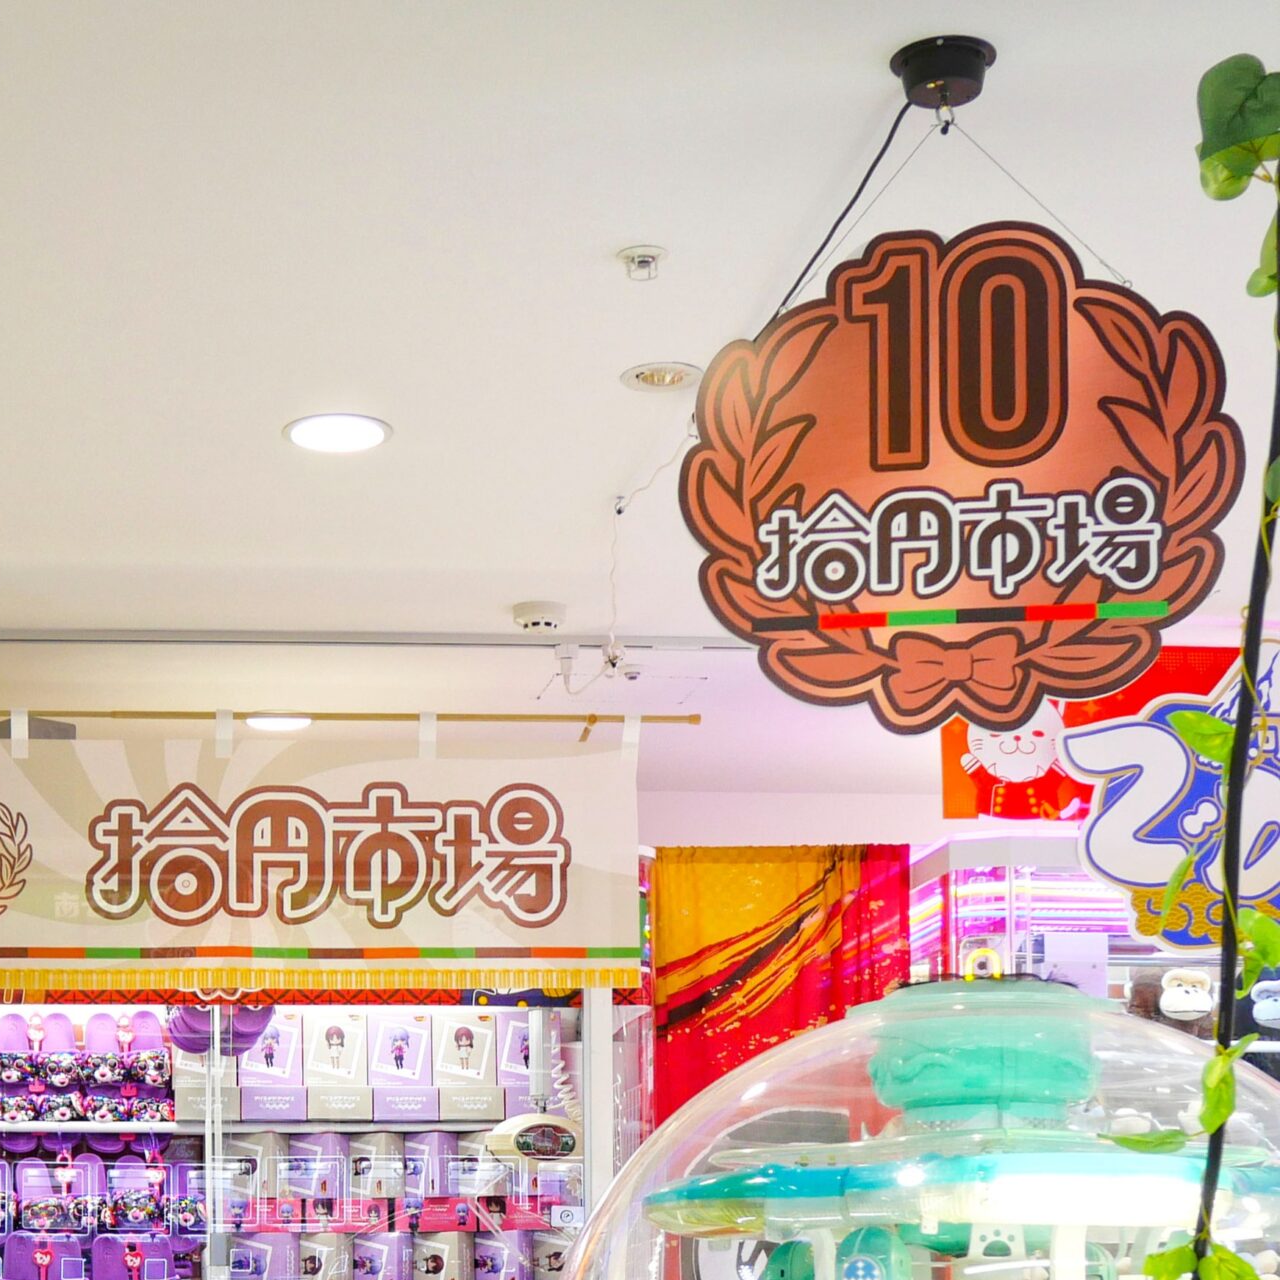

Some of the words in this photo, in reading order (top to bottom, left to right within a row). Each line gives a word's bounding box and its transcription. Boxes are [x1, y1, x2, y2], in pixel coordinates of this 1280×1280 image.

[845, 238, 1068, 470] 10
[755, 477, 1164, 603] 拾円市場
[86, 781, 572, 929] 拾円市場
[34, 1250, 51, 1265] ty
[124, 1253, 141, 1268] ty
